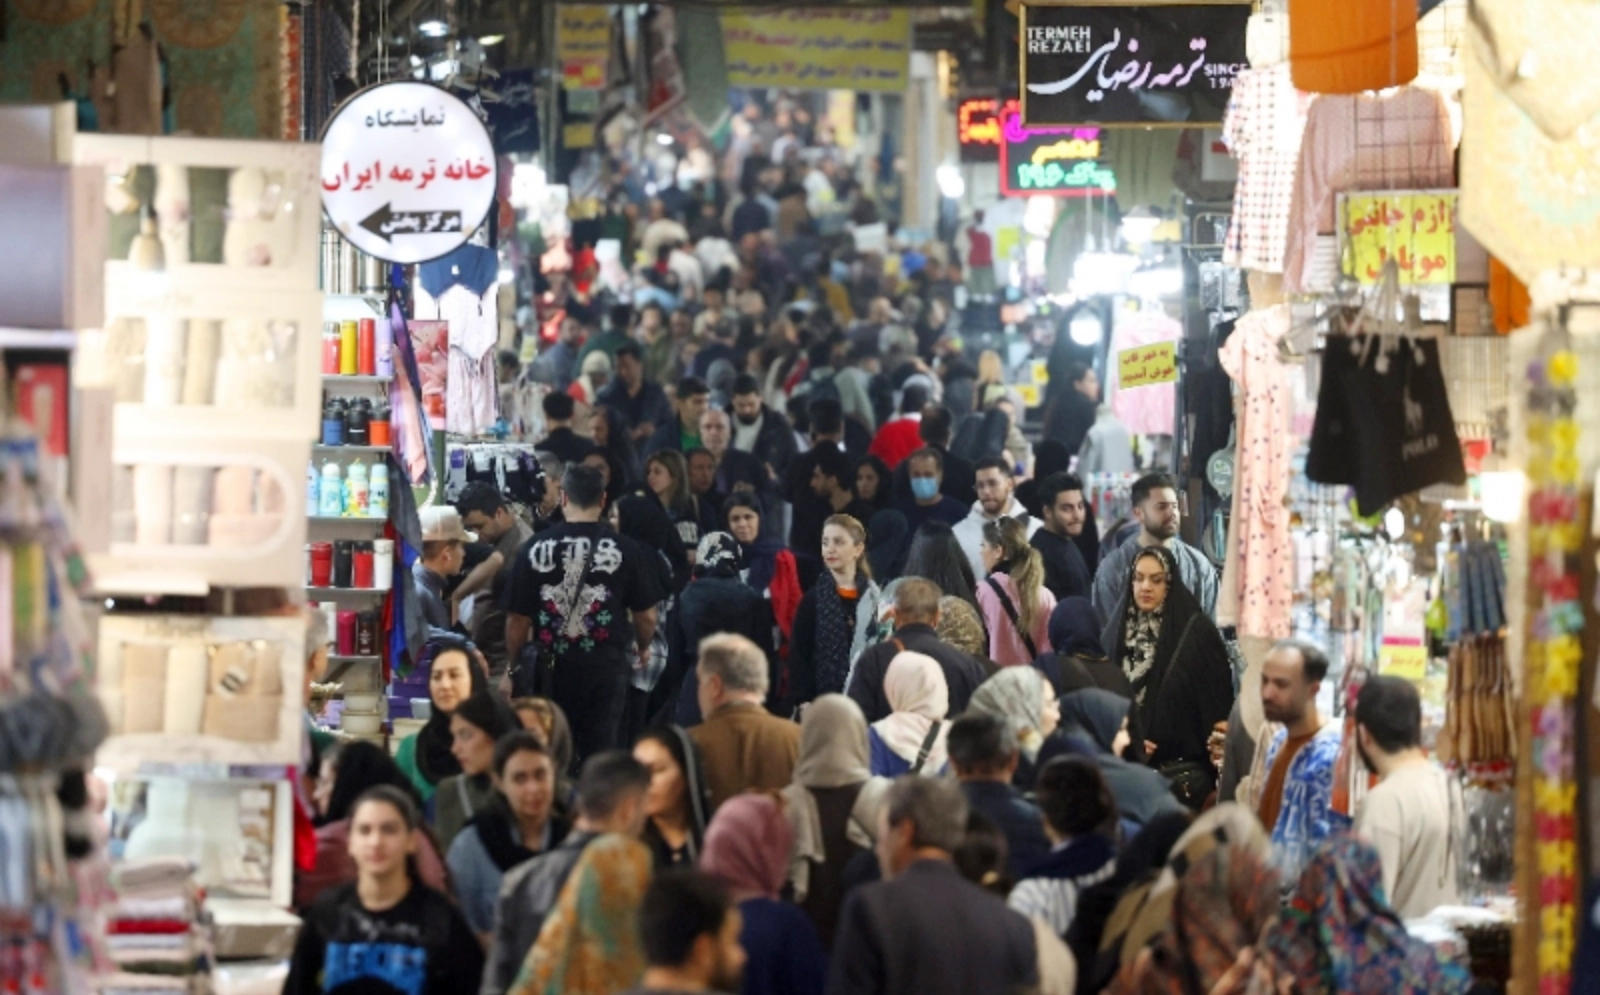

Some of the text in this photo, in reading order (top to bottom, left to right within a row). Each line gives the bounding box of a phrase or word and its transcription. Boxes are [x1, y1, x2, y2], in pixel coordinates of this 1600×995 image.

[1027, 25, 1091, 40] TERMEH
[1028, 40, 1091, 54] REZAEI
[1148, 37, 1207, 88] ترمه
[365, 106, 446, 132] نمایشگاه
[322, 157, 491, 191] خانه ترمه ایران
[380, 210, 460, 234] مرکز پخش
